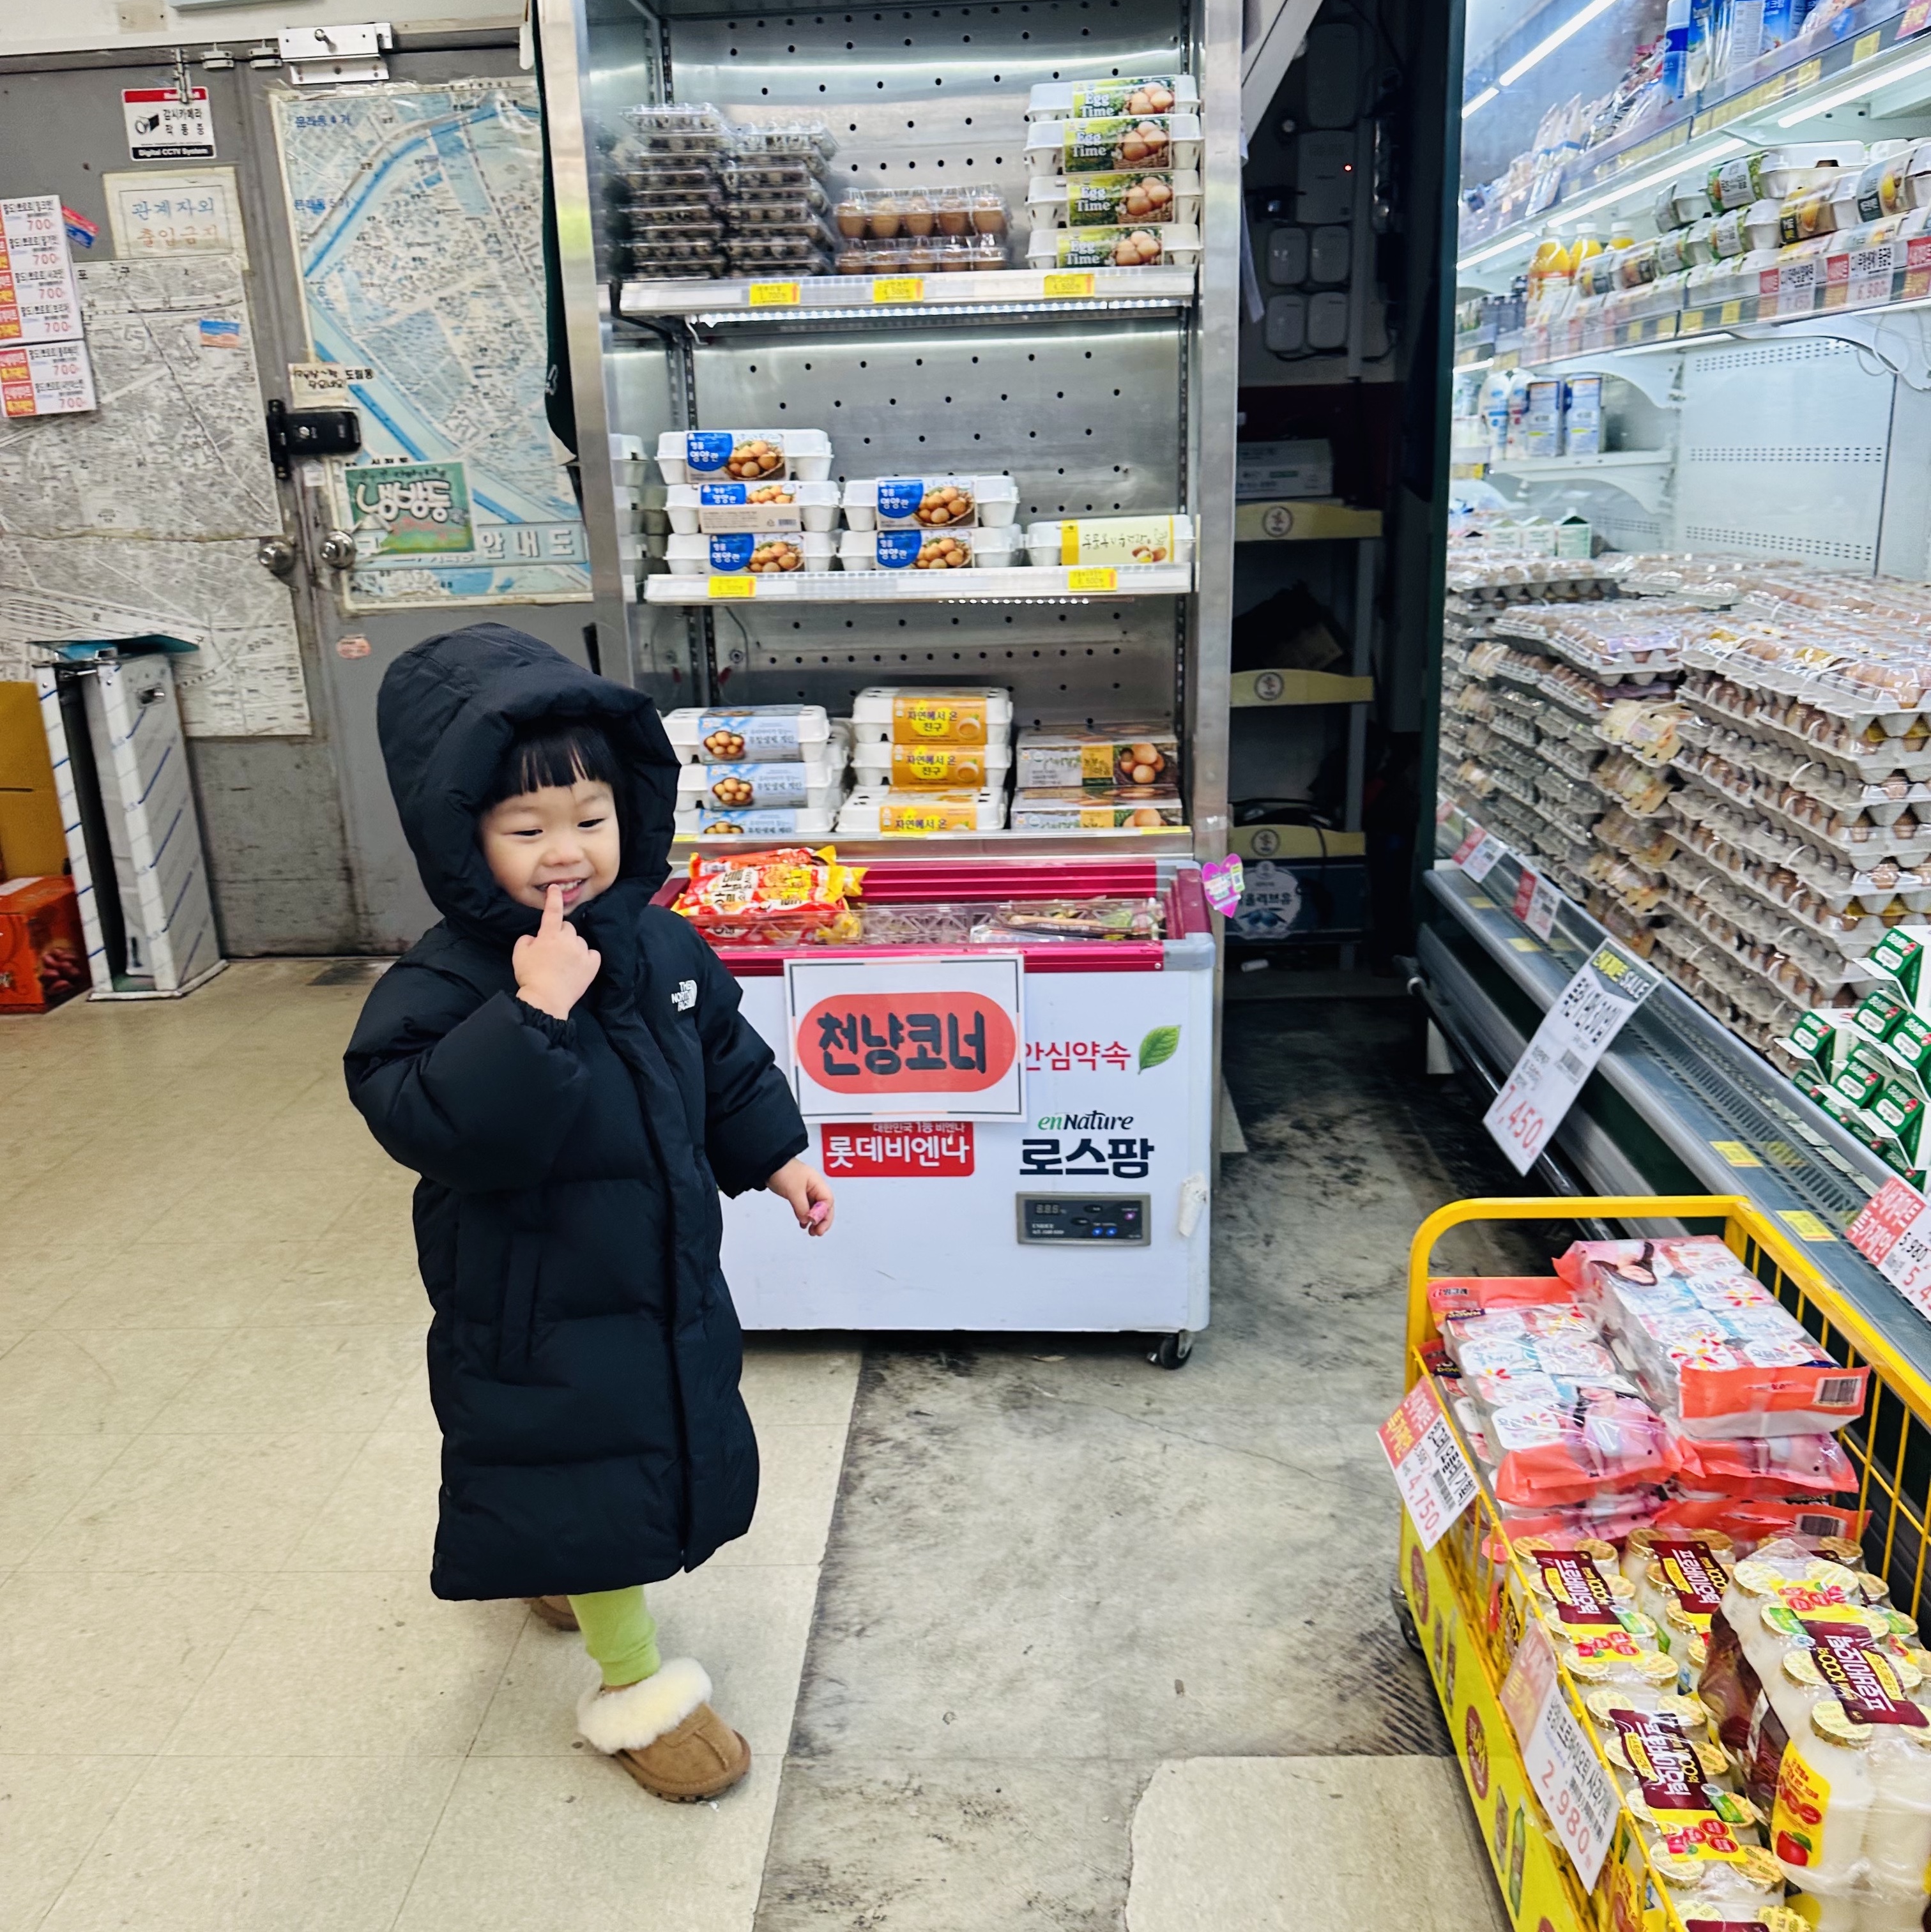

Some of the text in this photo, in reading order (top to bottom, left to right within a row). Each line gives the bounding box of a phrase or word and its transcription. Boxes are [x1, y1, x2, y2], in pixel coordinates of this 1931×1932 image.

[1085, 93, 1110, 107] Egg
[1079, 105, 1115, 118] Time
[1077, 132, 1103, 145] Egg
[1072, 144, 1107, 158] Time
[1081, 186, 1107, 201] Egg
[1076, 199, 1112, 212] Time
[27, 218, 51, 232] 700
[1070, 240, 1095, 255] Egg
[33, 253, 57, 266] 700
[1066, 253, 1101, 266] Time
[38, 287, 64, 300] 700
[45, 321, 70, 333] 700
[53, 363, 78, 376] 700
[59, 397, 83, 409] 700
[1619, 970, 1651, 1000] SALE
[816, 1010, 987, 1076] 천냥코너
[1025, 1040, 1132, 1072] 안심약속
[1037, 1109, 1134, 1130] enNature
[1495, 1084, 1544, 1150] 7,450
[825, 1134, 970, 1169] 롯데비엔나
[1019, 1137, 1155, 1179] 로스팡
[1408, 1473, 1440, 1531] 4,750
[1671, 1548, 1721, 1604] 프로바이오틱
[1554, 1558, 1601, 1615] 프로바이오틱
[1824, 1634, 1896, 1712] 프로바이오틱
[1635, 1721, 1691, 1796] 프로바이오틱
[1540, 1758, 1592, 1855] 2,980
